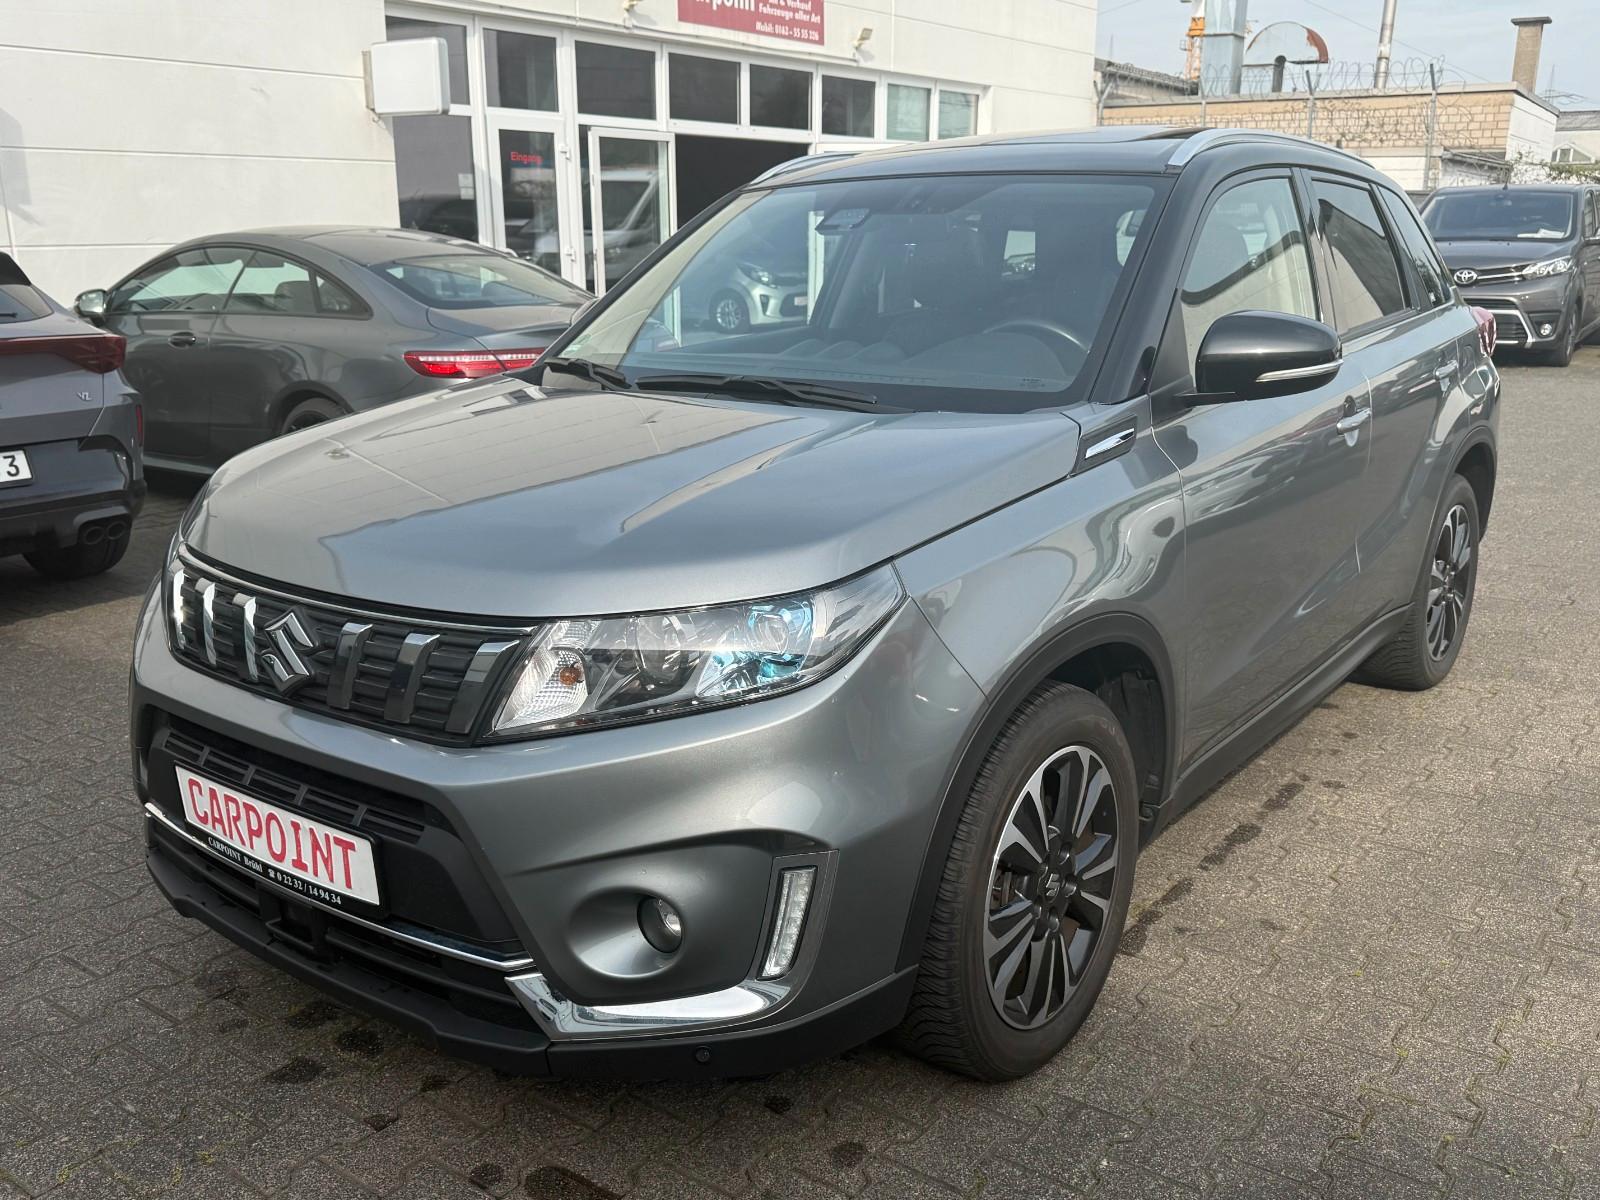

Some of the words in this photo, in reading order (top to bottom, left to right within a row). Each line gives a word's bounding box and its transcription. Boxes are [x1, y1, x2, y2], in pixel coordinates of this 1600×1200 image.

[758, 3, 793, 21] Fahrzeuge
[794, 10, 810, 22] aller
[811, 13, 820, 23] Art
[756, 21, 774, 33] Mobil:
[2, 454, 20, 477] 3
[188, 777, 357, 889] CARPOINT
[208, 836, 242, 862] CARPOINT
[243, 855, 263, 873] Brühl
[276, 871, 282, 882] 0
[283, 874, 293, 886] 22
[293, 878, 303, 890] 32
[308, 885, 319, 897] 14
[319, 889, 330, 901] 94
[330, 893, 342, 905] 34
